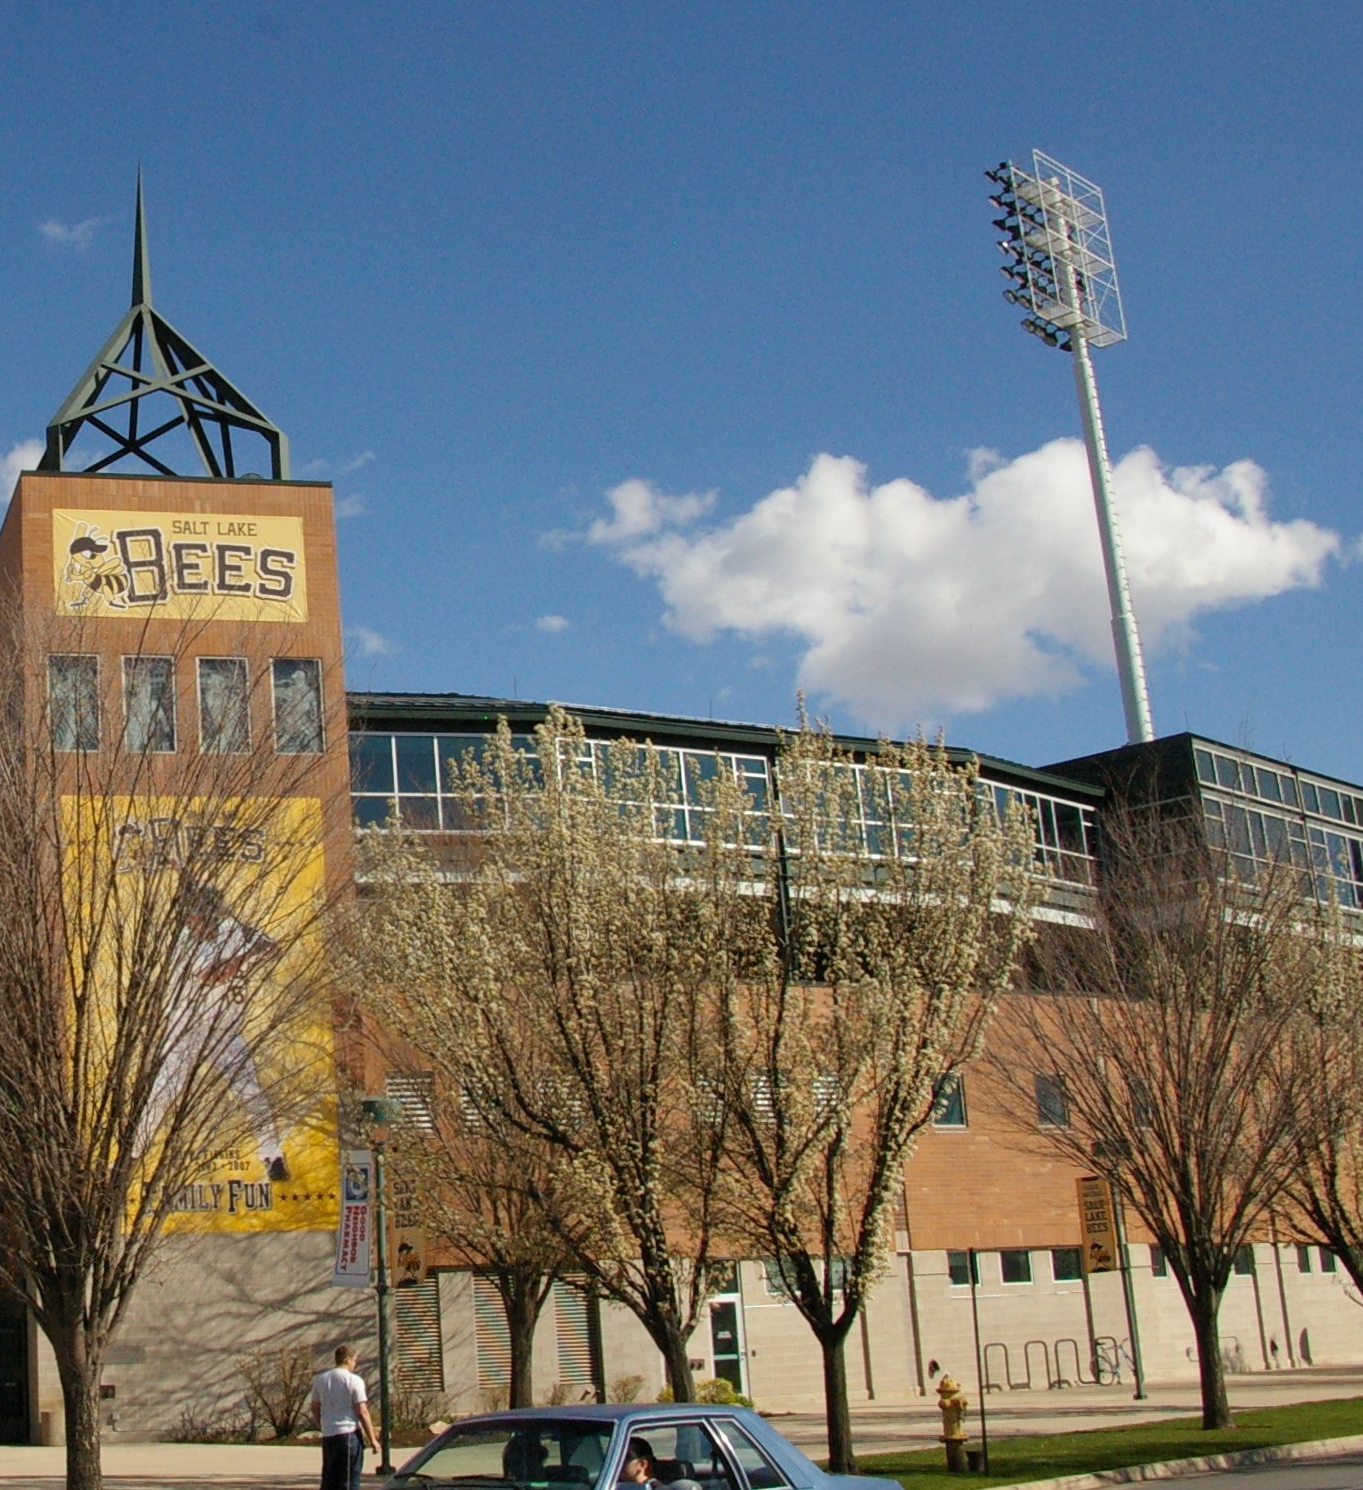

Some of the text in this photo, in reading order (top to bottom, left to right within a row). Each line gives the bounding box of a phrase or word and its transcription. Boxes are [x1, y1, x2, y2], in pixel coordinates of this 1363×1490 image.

[172, 520, 258, 537] SALT LAKE
[114, 527, 296, 607] BEES
[227, 1180, 271, 1213] FUN
